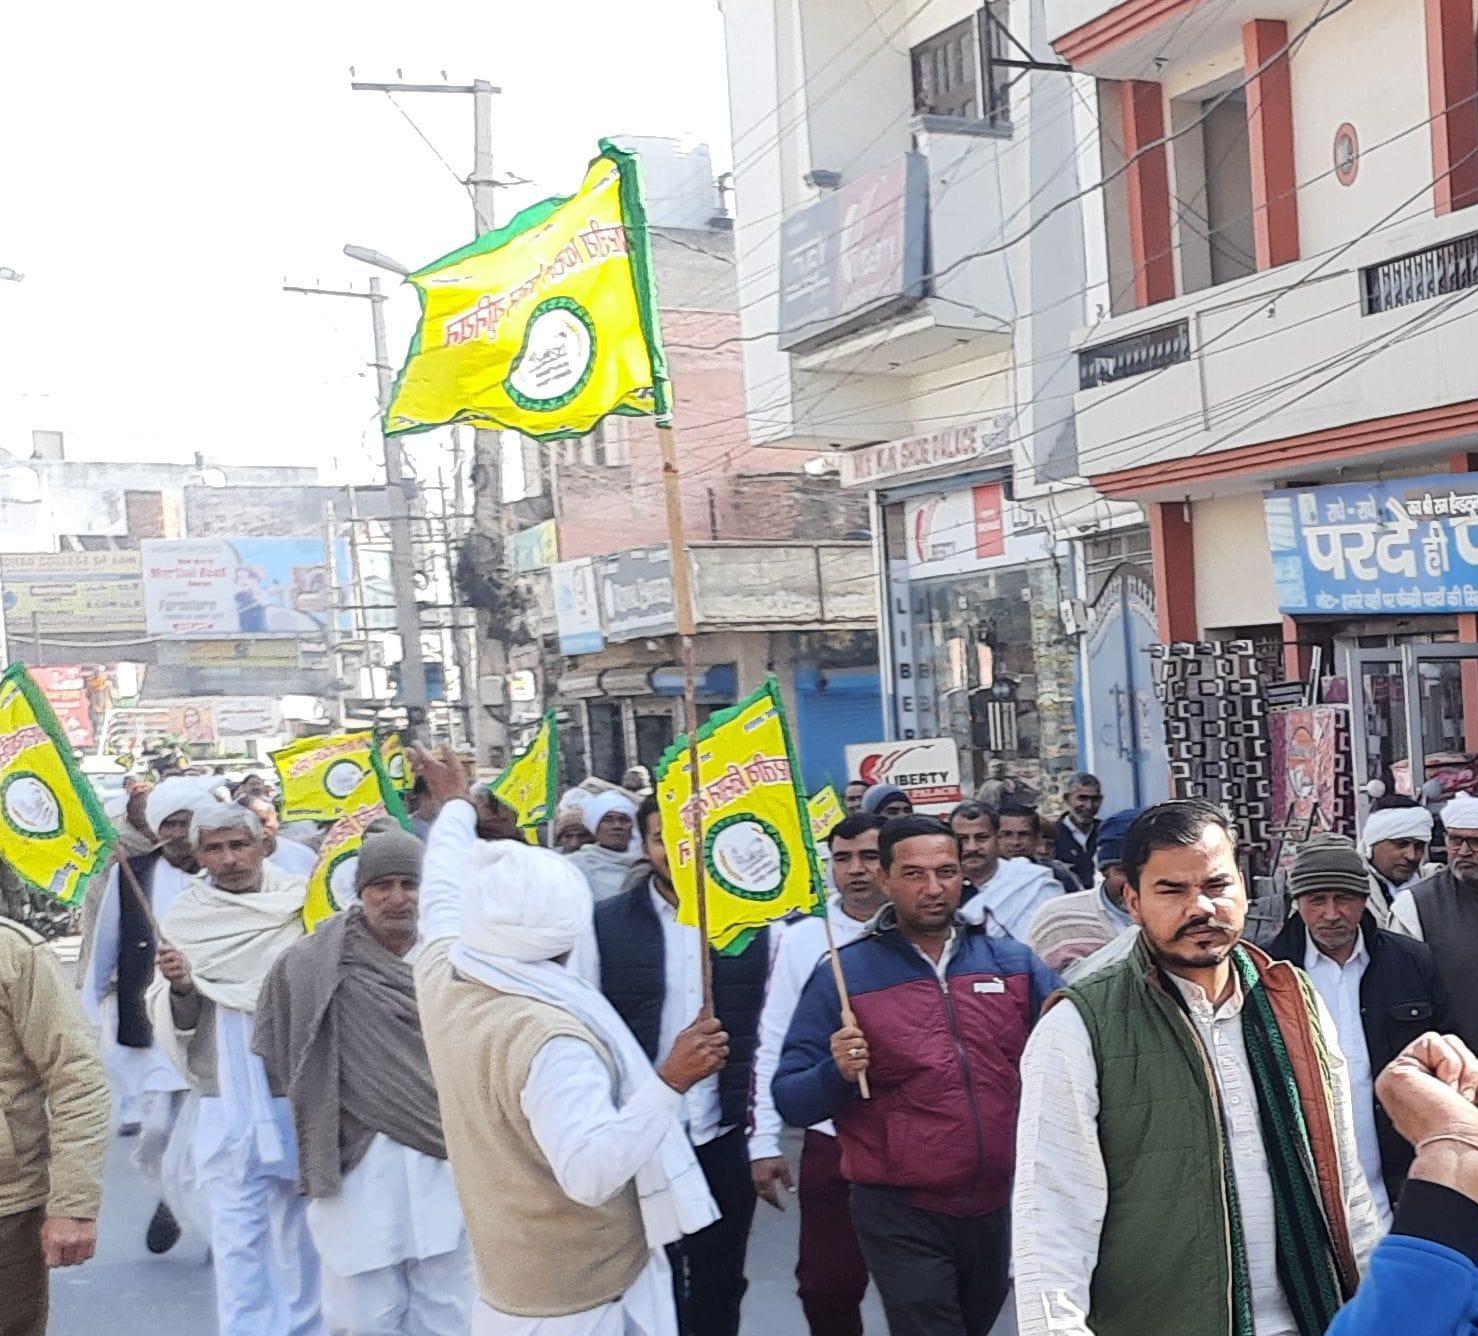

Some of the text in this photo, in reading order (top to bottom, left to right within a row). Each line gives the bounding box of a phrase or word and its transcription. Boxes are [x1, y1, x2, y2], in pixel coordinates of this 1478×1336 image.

[1301, 496, 1418, 582] परदे
[1421, 520, 1450, 577] ही
[885, 771, 949, 787] LIBERTY
